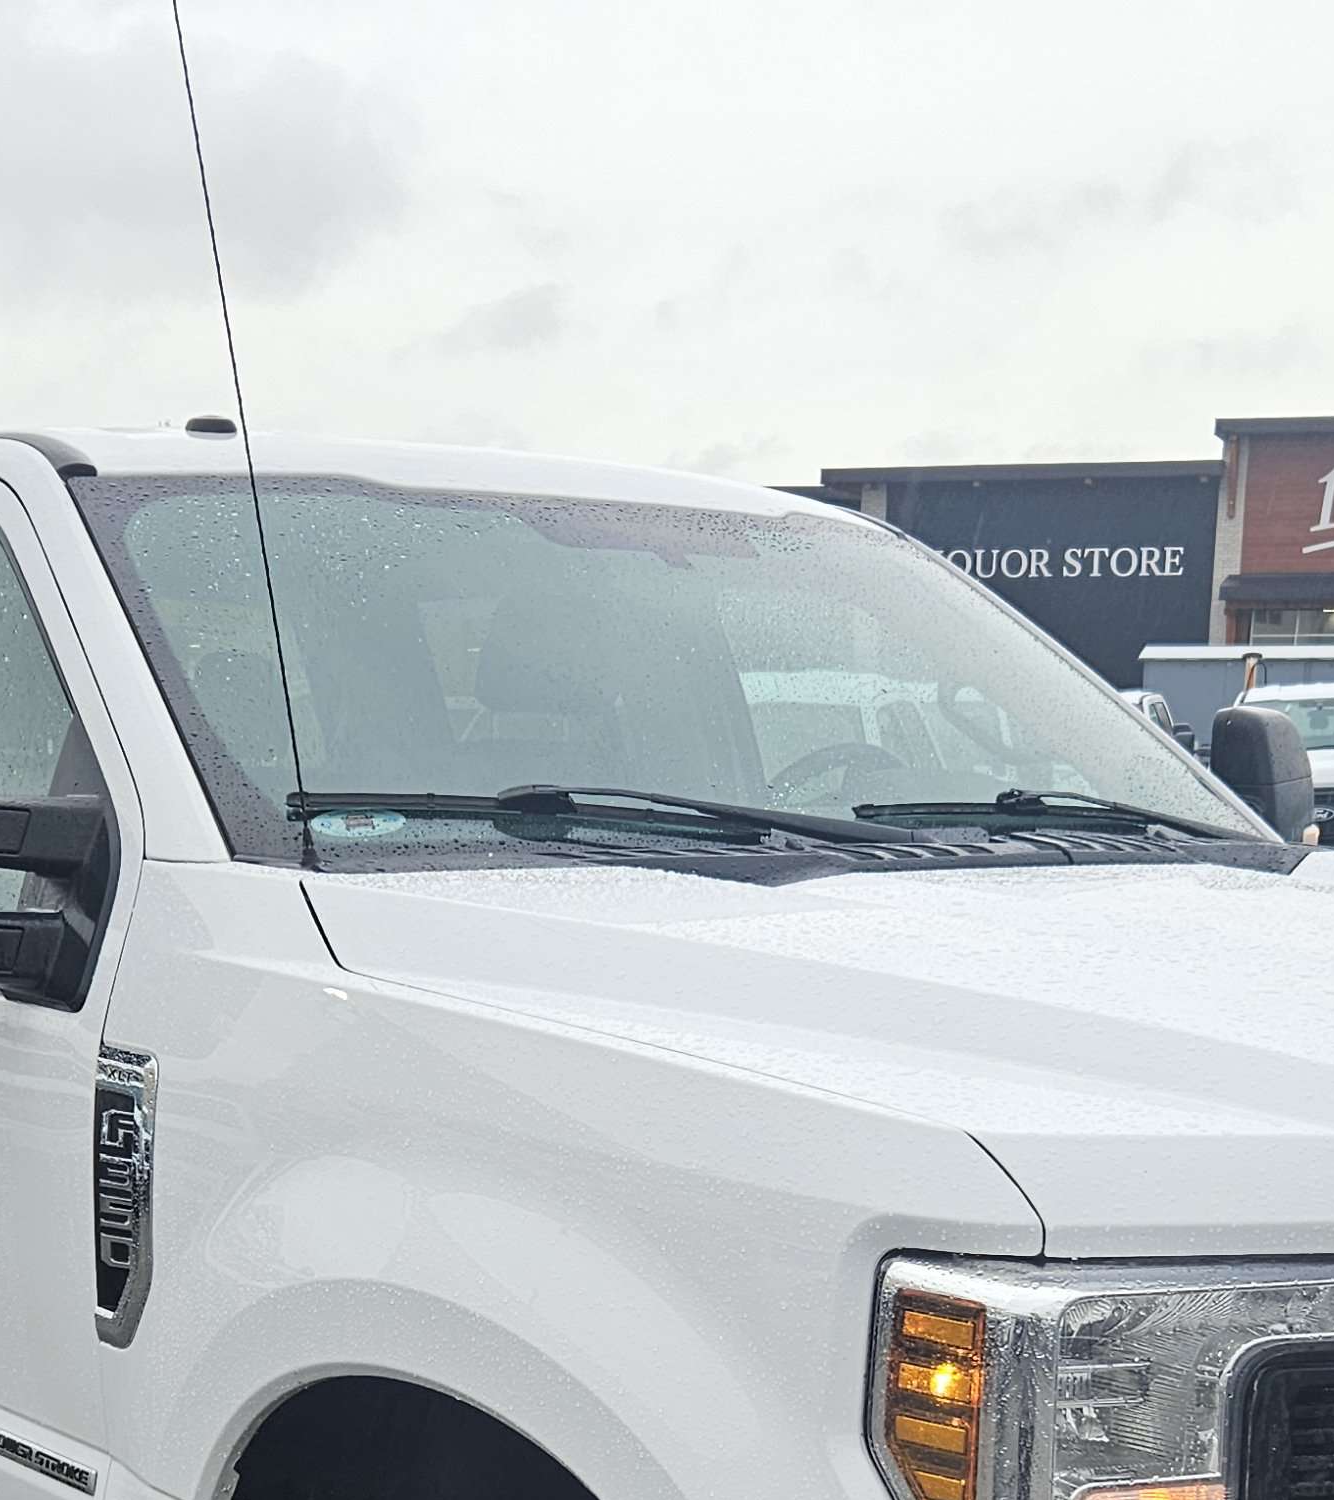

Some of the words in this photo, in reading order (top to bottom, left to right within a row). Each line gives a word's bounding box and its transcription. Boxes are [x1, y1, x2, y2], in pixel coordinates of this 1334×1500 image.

[1062, 547, 1184, 577] STORE
[108, 1066, 134, 1083] XLT
[35, 1451, 90, 1486] STROKE
